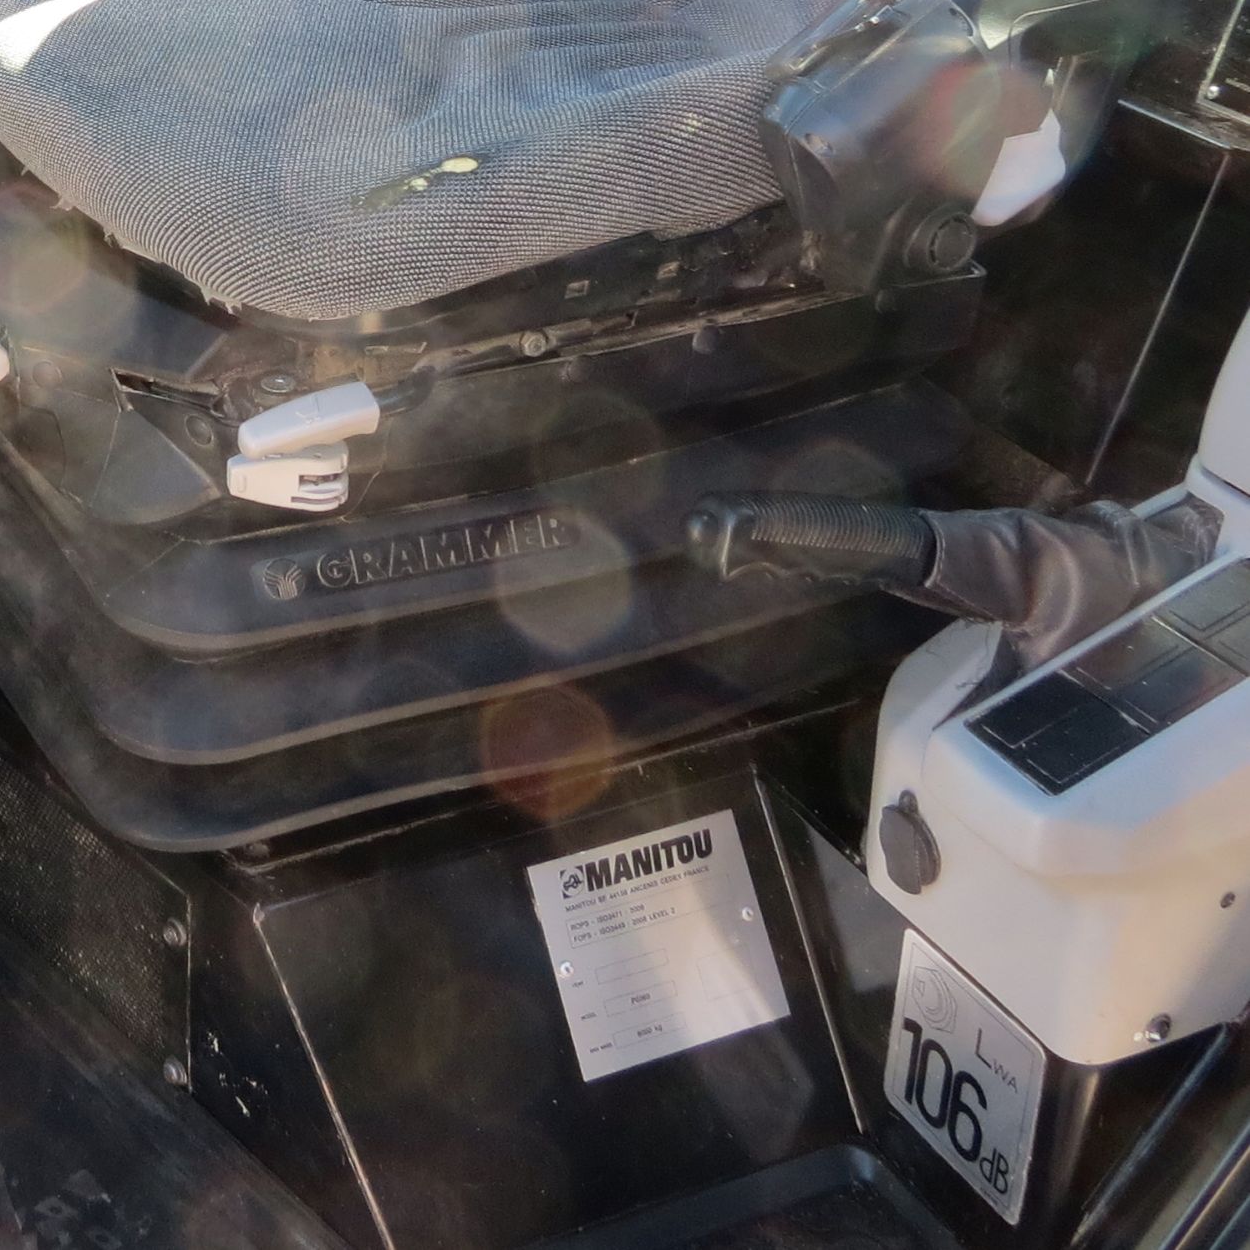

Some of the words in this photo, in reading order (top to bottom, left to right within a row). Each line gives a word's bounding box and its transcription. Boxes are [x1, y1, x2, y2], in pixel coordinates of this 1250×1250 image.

[316, 514, 568, 588] GRAMMER
[584, 829, 713, 892] MANITOU
[903, 1017, 988, 1163] 106
[979, 1147, 1010, 1195] dB
